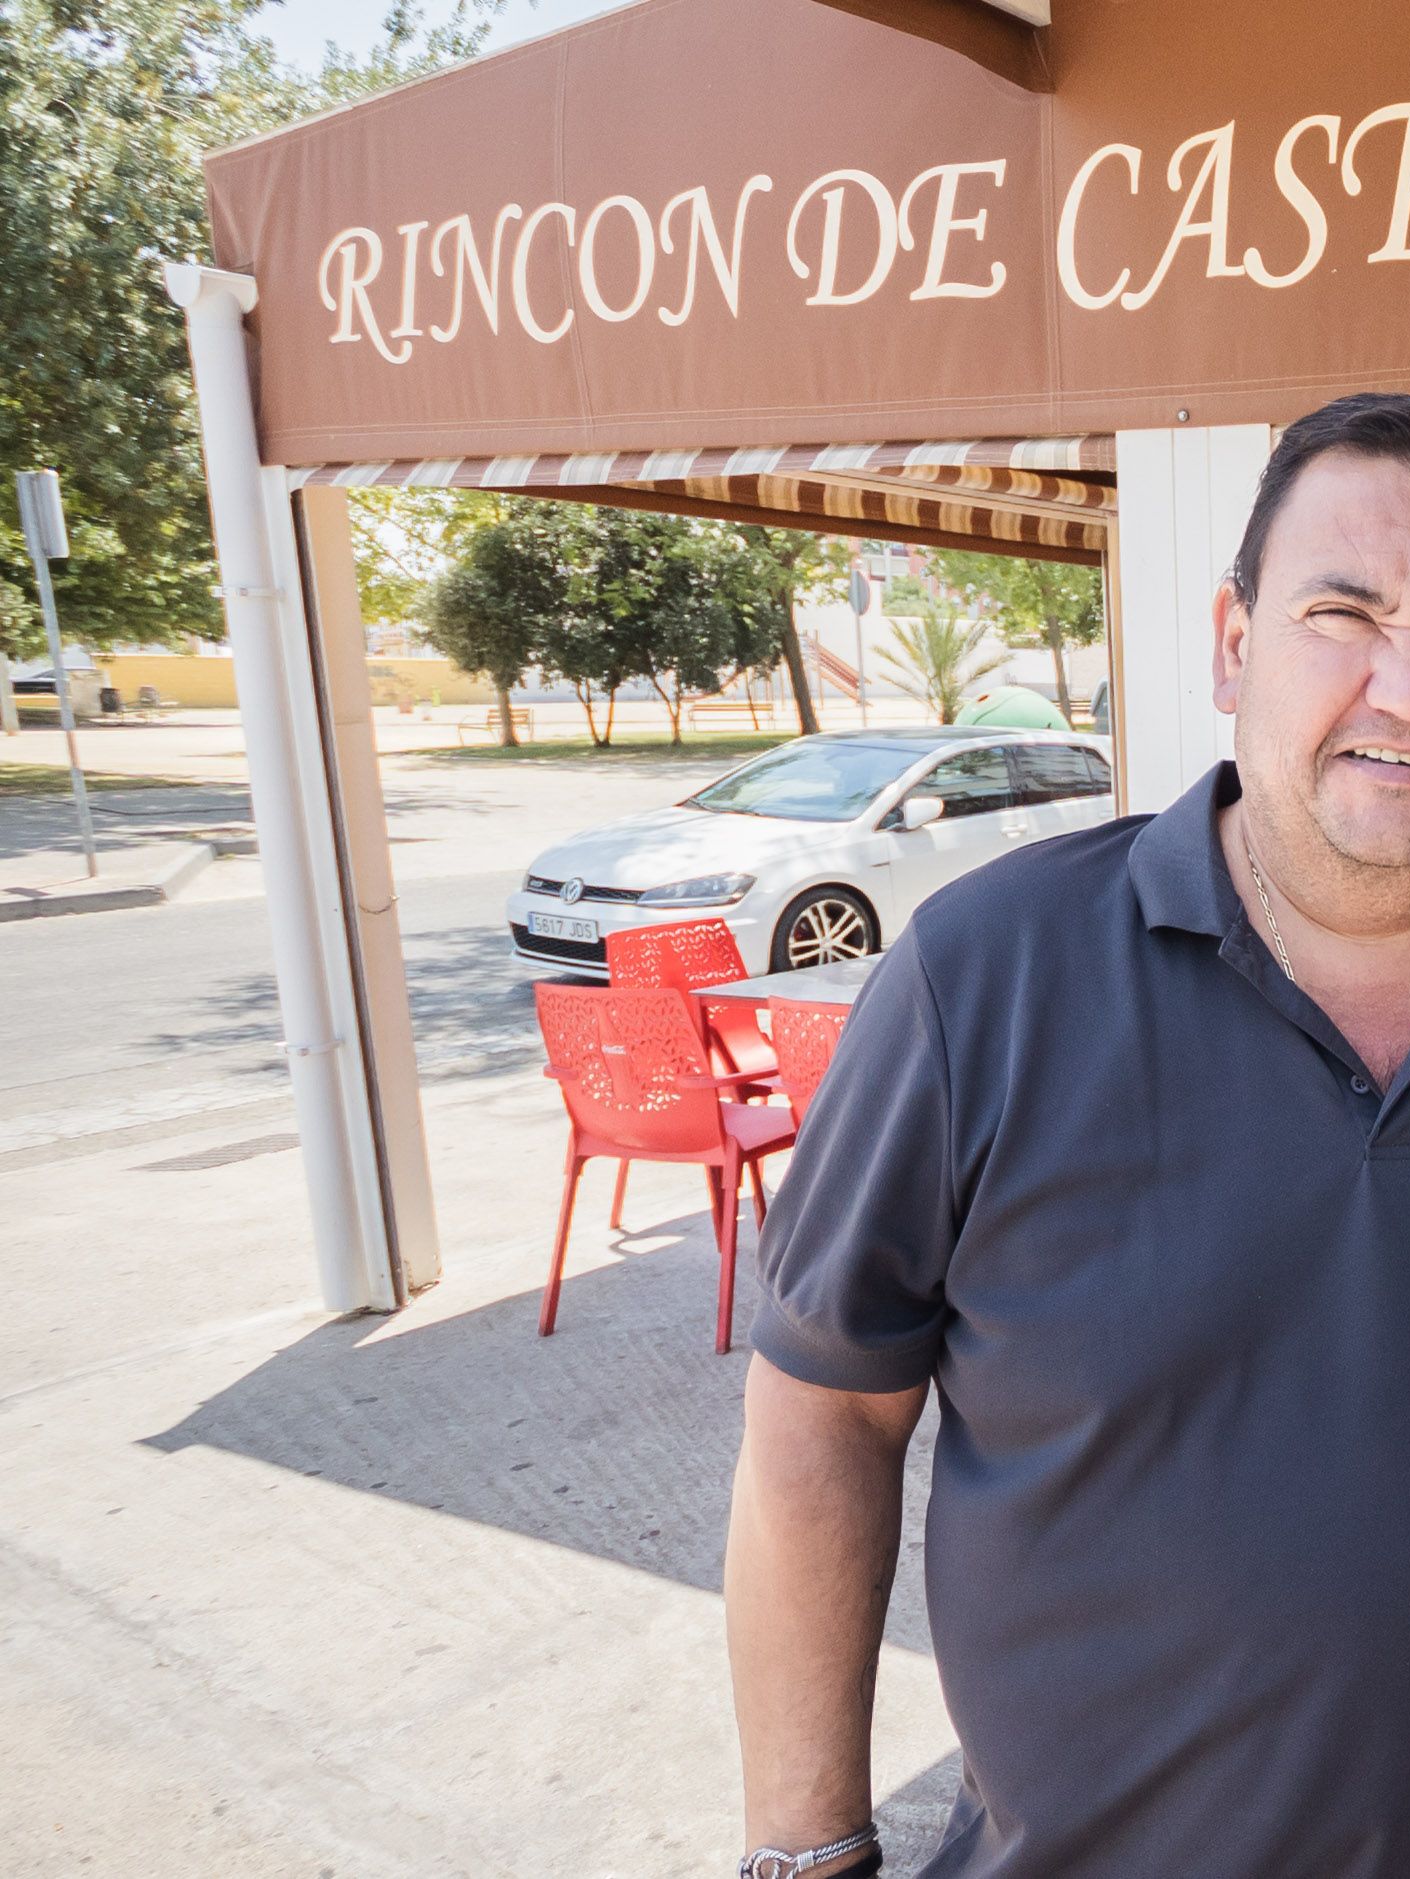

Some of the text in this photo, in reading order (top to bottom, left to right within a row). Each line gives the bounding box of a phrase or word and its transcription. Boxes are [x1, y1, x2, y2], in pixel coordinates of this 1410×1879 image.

[319, 174, 774, 365] RINCON
[786, 158, 1008, 306] DE
[569, 920, 592, 939] JDS
